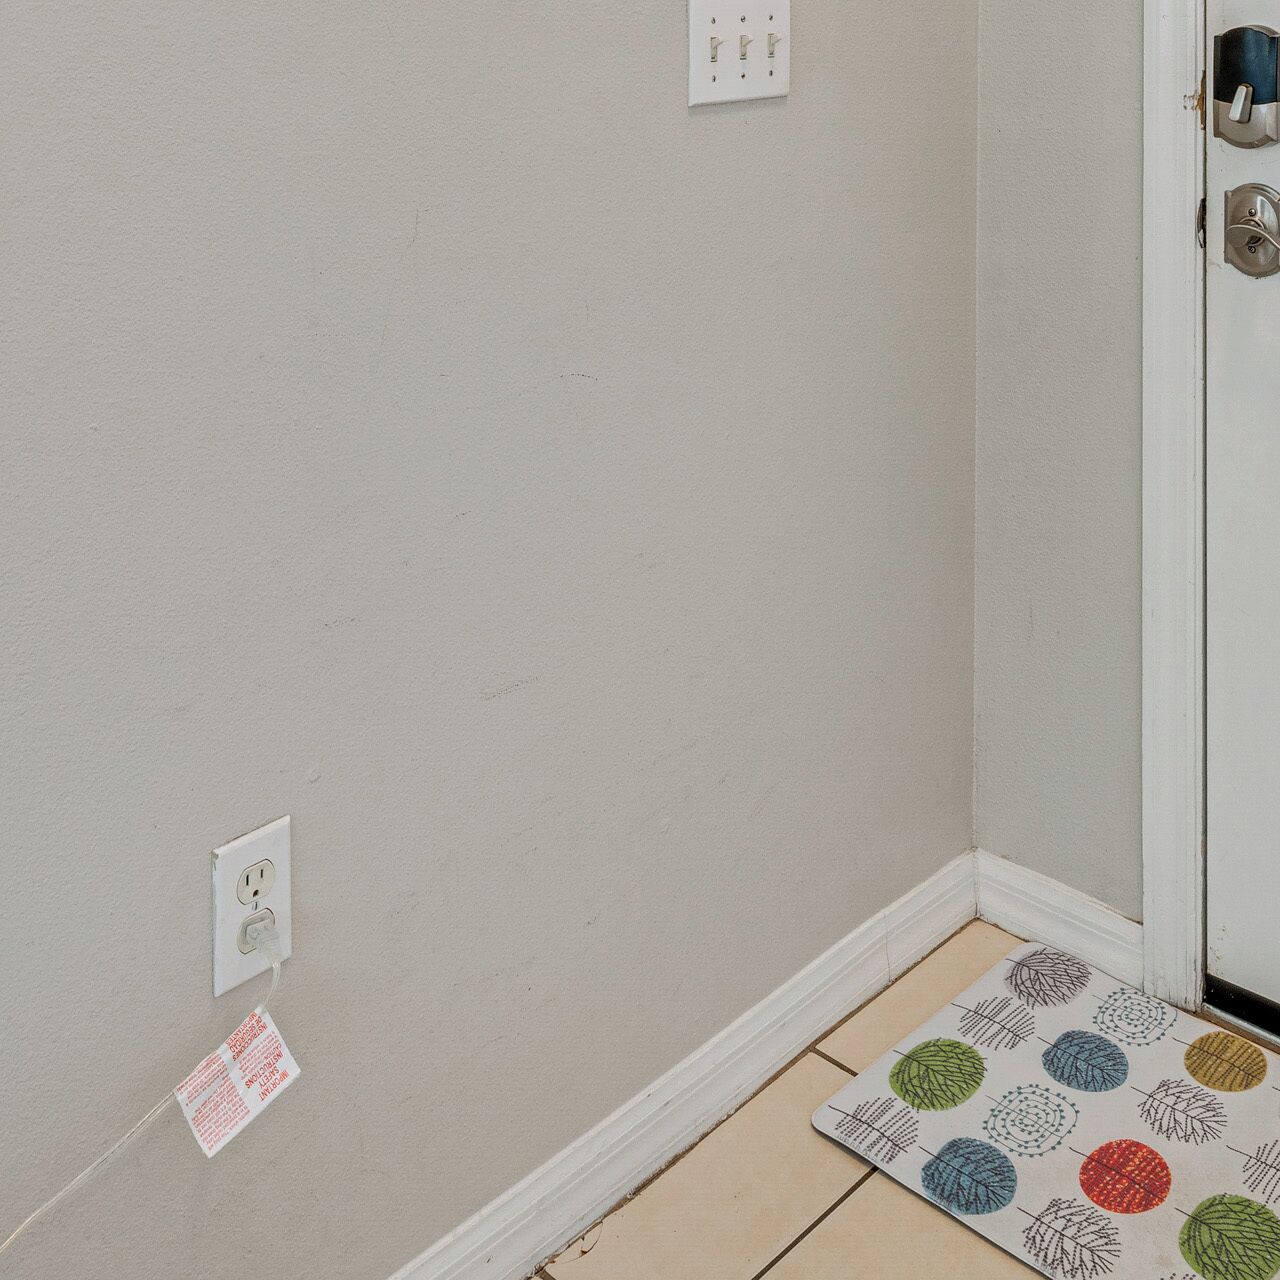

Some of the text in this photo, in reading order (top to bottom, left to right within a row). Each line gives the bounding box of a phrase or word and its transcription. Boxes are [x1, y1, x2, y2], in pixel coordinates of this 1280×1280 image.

[245, 1050, 283, 1089] INSTRUCTIONS
[258, 1065, 279, 1089] SAFETY
[259, 1070, 289, 1102] IMPORTANT
